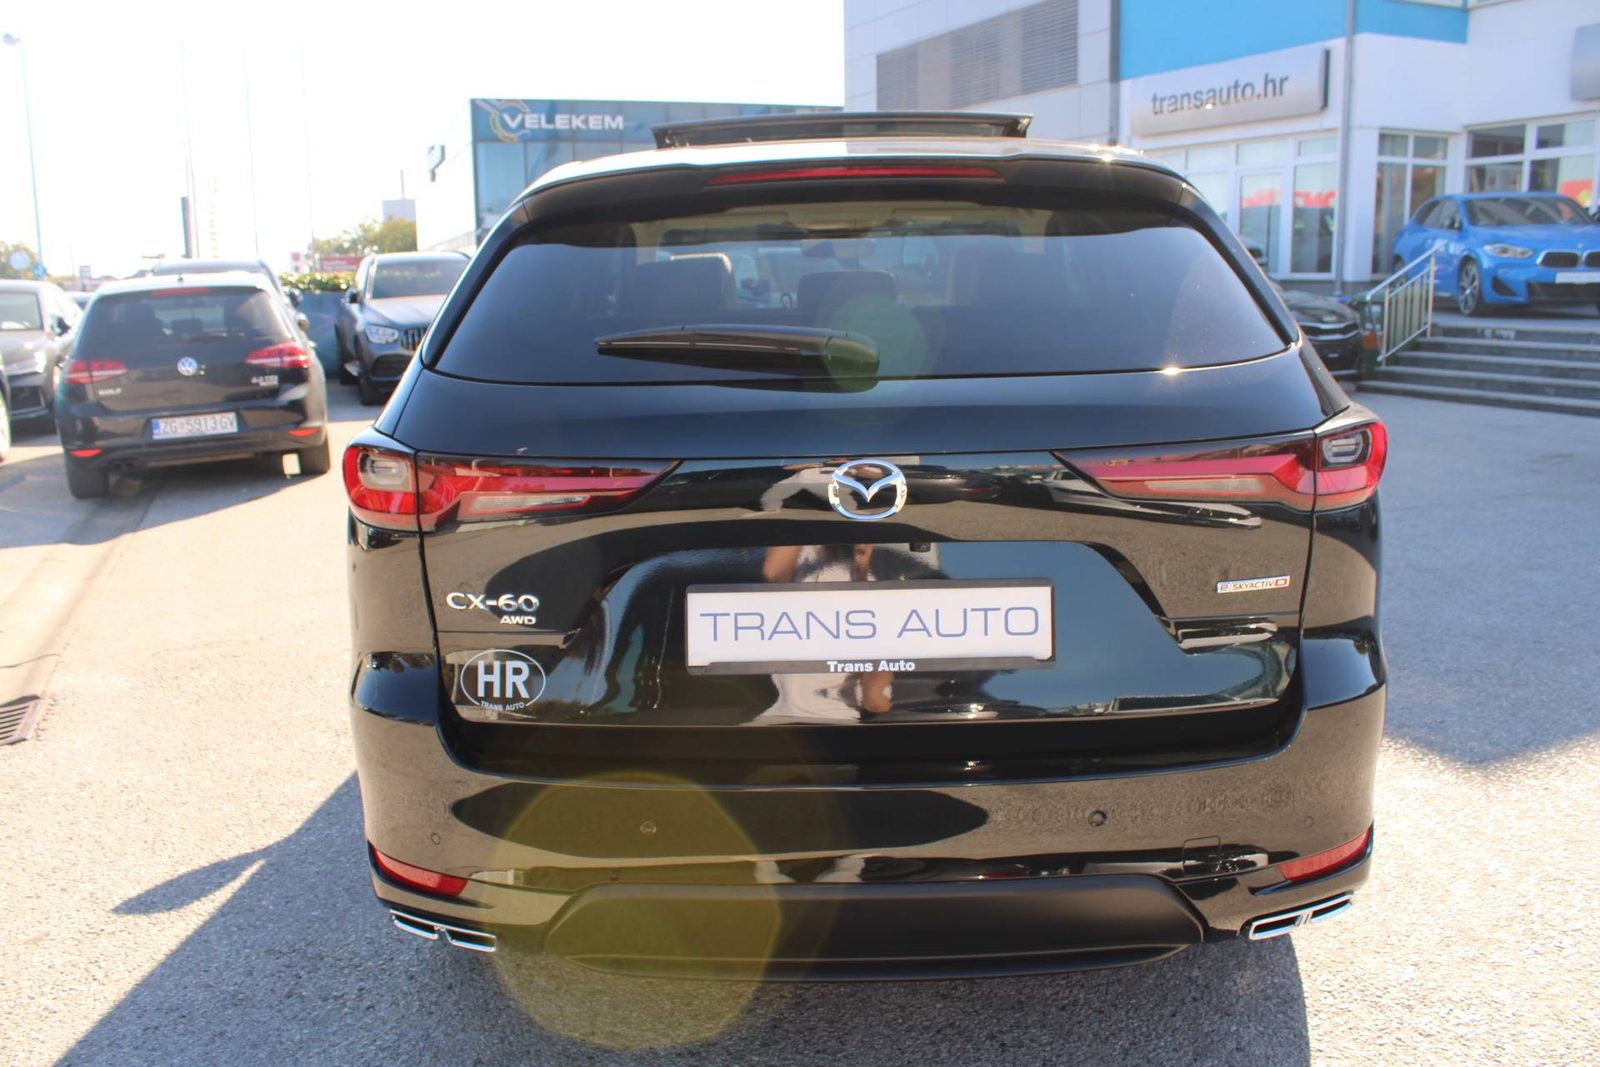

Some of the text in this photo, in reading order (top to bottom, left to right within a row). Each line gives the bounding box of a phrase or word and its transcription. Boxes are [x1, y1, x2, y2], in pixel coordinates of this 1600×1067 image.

[1151, 72, 1289, 115] transauto.hr
[502, 113, 624, 130] VELEKEM
[446, 592, 540, 612] CX-60
[500, 615, 537, 625] AWD
[699, 606, 1040, 642] TRANS AUTO
[827, 659, 915, 673] Trans Auto
[477, 660, 530, 699] HR
[480, 700, 525, 712] TRANS AUTO
